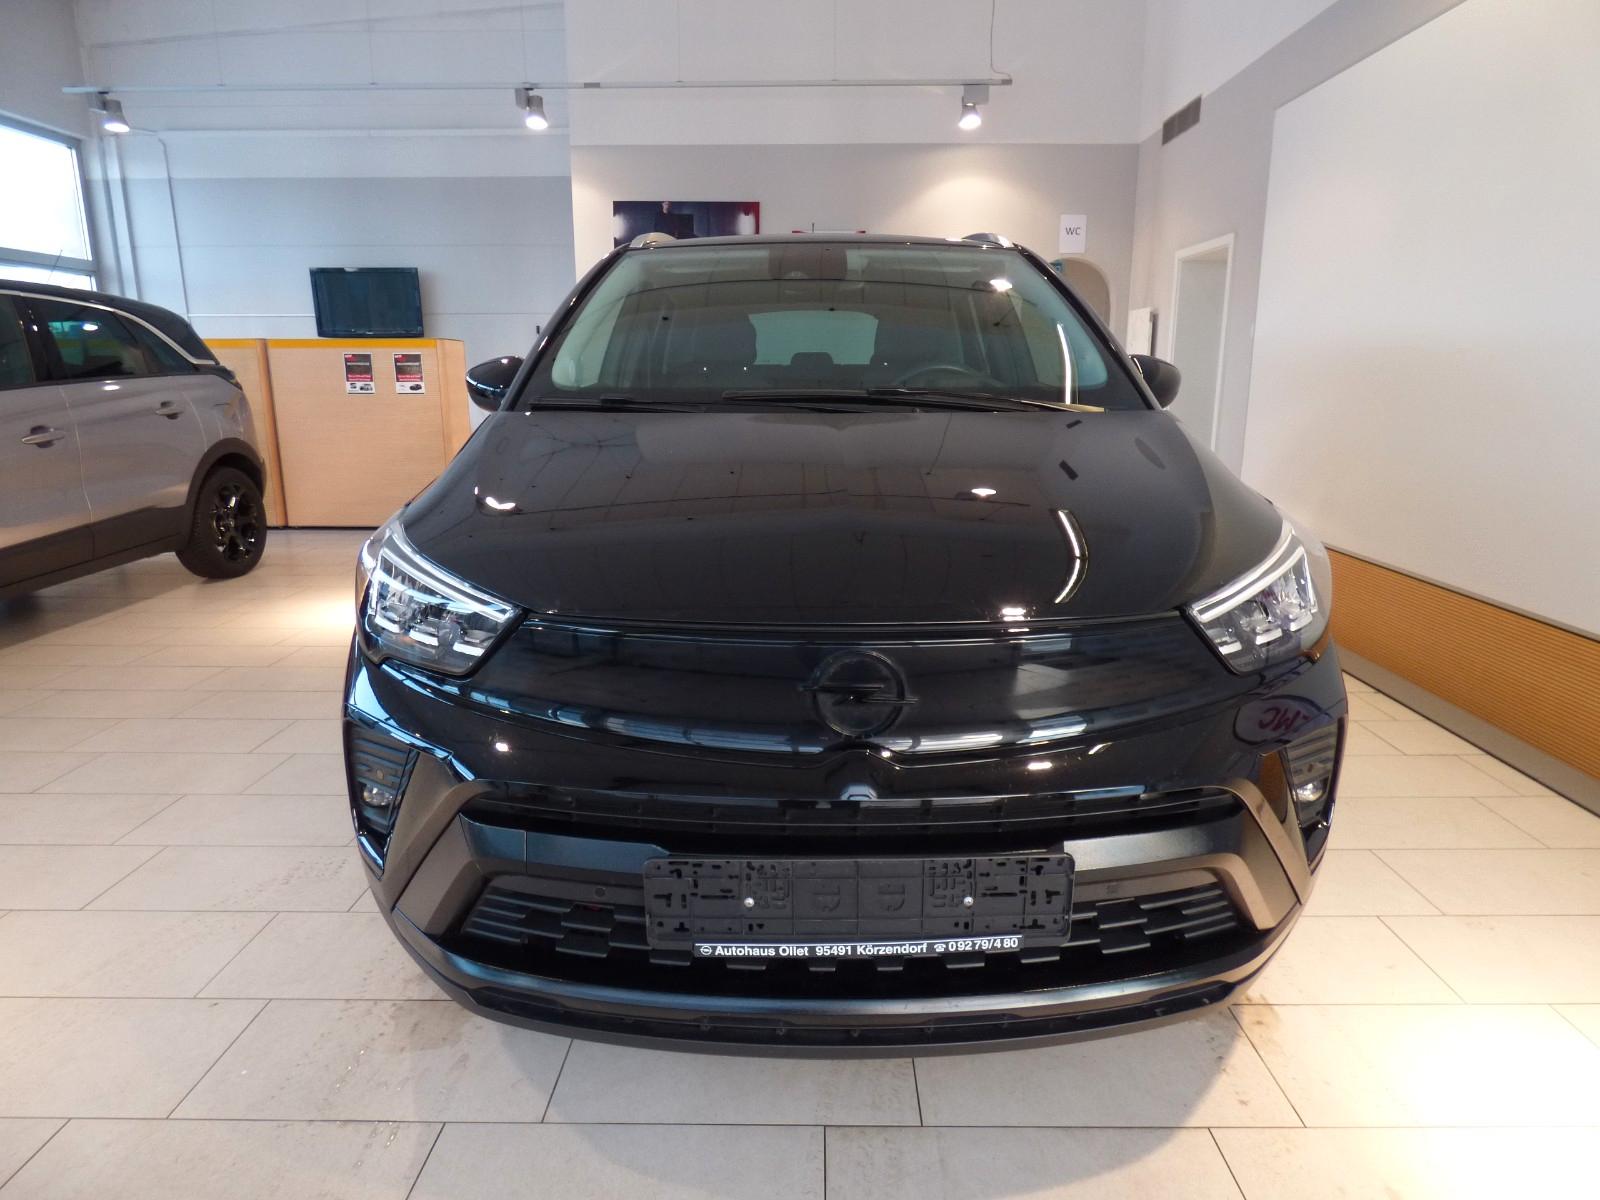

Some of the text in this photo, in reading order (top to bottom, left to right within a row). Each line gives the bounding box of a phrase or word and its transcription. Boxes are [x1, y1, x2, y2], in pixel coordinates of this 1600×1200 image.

[1065, 226, 1081, 236] WC
[714, 945, 776, 957] Autohaus
[815, 945, 852, 956] 95491
[856, 942, 928, 956] Körzendorf
